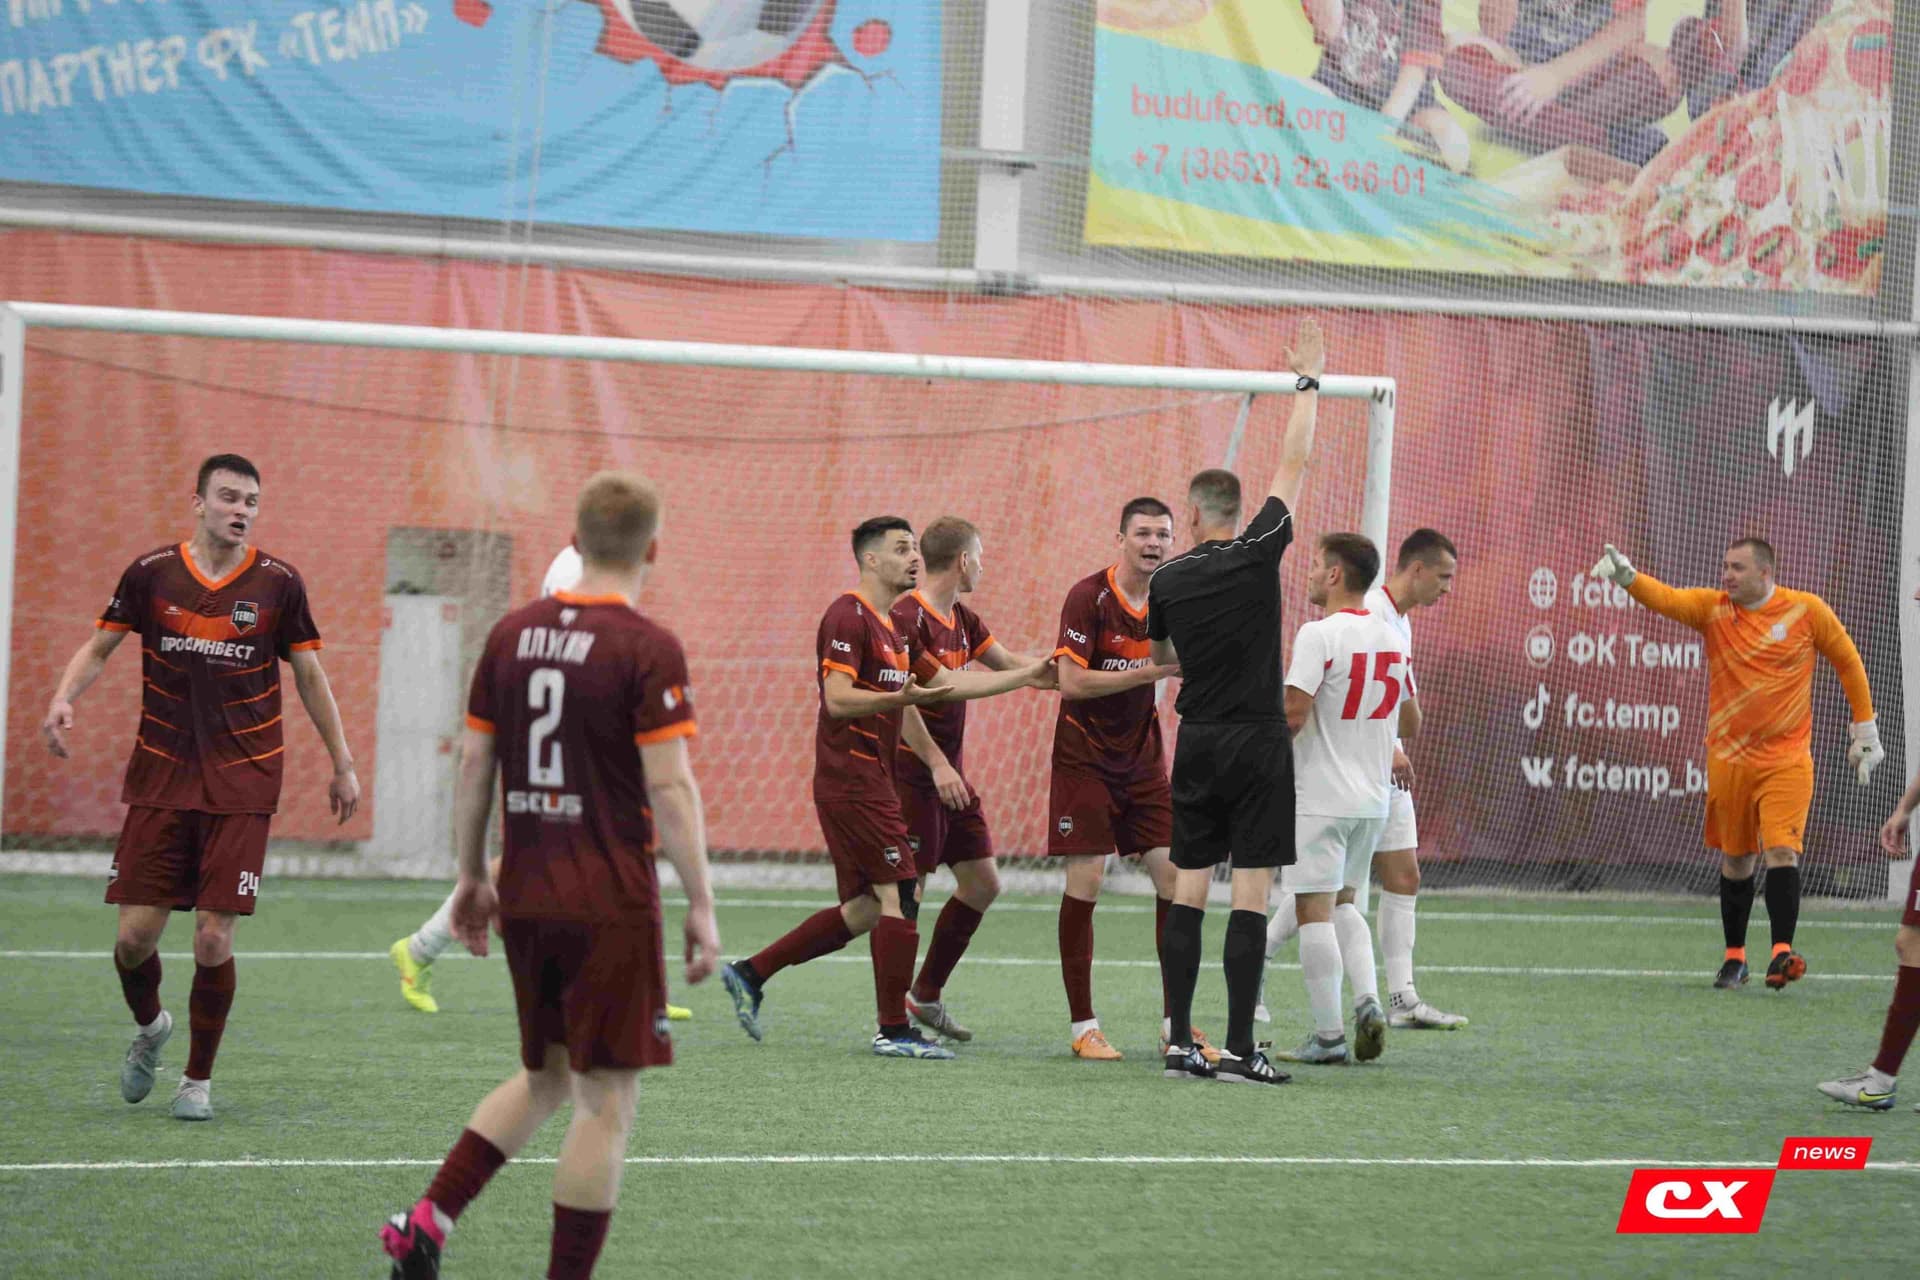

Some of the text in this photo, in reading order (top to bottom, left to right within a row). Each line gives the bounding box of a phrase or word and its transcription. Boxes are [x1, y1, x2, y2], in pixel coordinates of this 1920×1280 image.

[0, 34, 187, 115] ПАРТНЕР
[197, 19, 271, 81] ФК
[1131, 83, 1347, 143] budufood.org
[1131, 144, 1171, 176] +7
[1292, 153, 1427, 197] 22-66-01
[831, 639, 851, 653] ПСБ
[1066, 628, 1087, 644] ПСБ
[1567, 631, 1701, 670] ФК Темп
[1341, 651, 1402, 720] 15
[528, 667, 566, 787] 2
[1564, 692, 1680, 738] fc.temp
[1564, 754, 1709, 800] fctemp_b
[237, 871, 260, 897] 24
